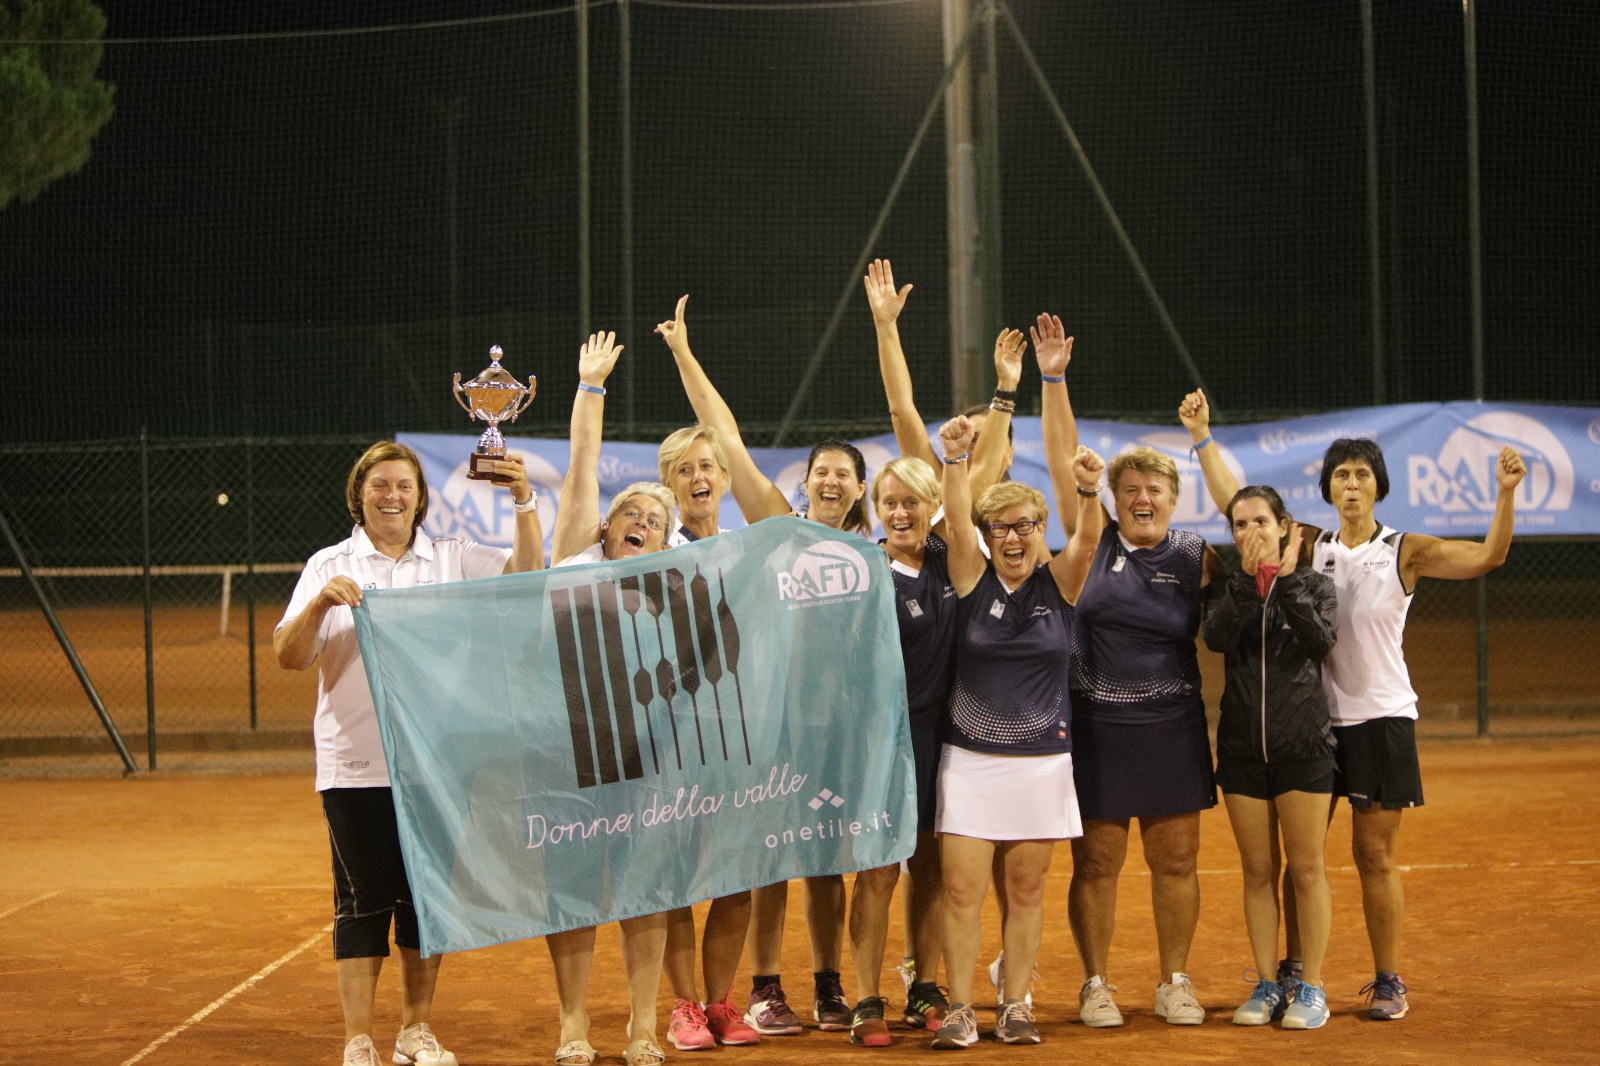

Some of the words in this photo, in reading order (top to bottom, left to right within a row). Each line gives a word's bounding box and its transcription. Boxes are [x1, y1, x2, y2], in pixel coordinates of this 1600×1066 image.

[777, 562, 851, 600] RAFT
[526, 812, 634, 850] Donne
[640, 784, 725, 828] della
[734, 763, 808, 808] valle
[765, 811, 893, 849] onetile.it
